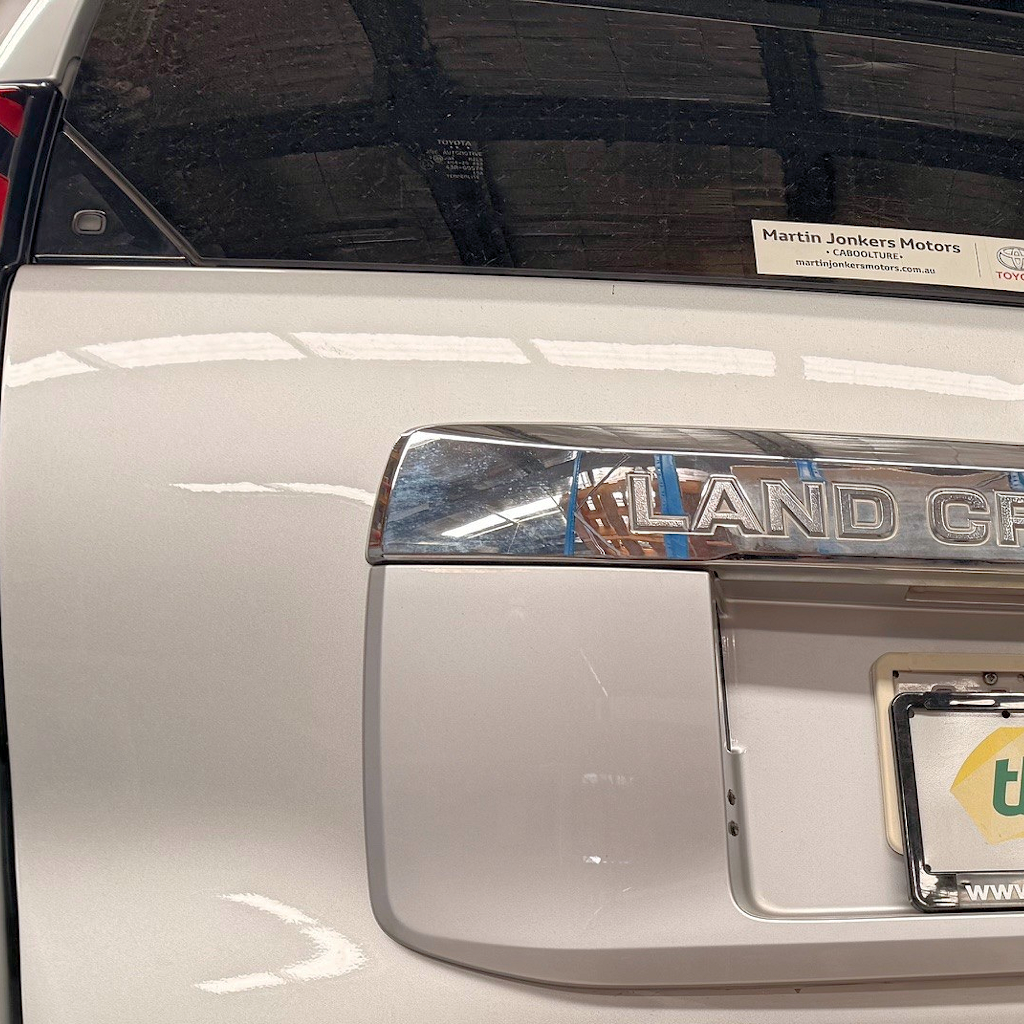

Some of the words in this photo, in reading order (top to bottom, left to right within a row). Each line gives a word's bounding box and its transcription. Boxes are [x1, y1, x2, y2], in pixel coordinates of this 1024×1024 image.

[762, 228, 822, 244] Martin
[826, 232, 896, 249] Jonkers
[900, 237, 961, 254] Motors
[795, 258, 936, 275] martinjonkersmotors.com.au
[626, 472, 898, 541] LAND
